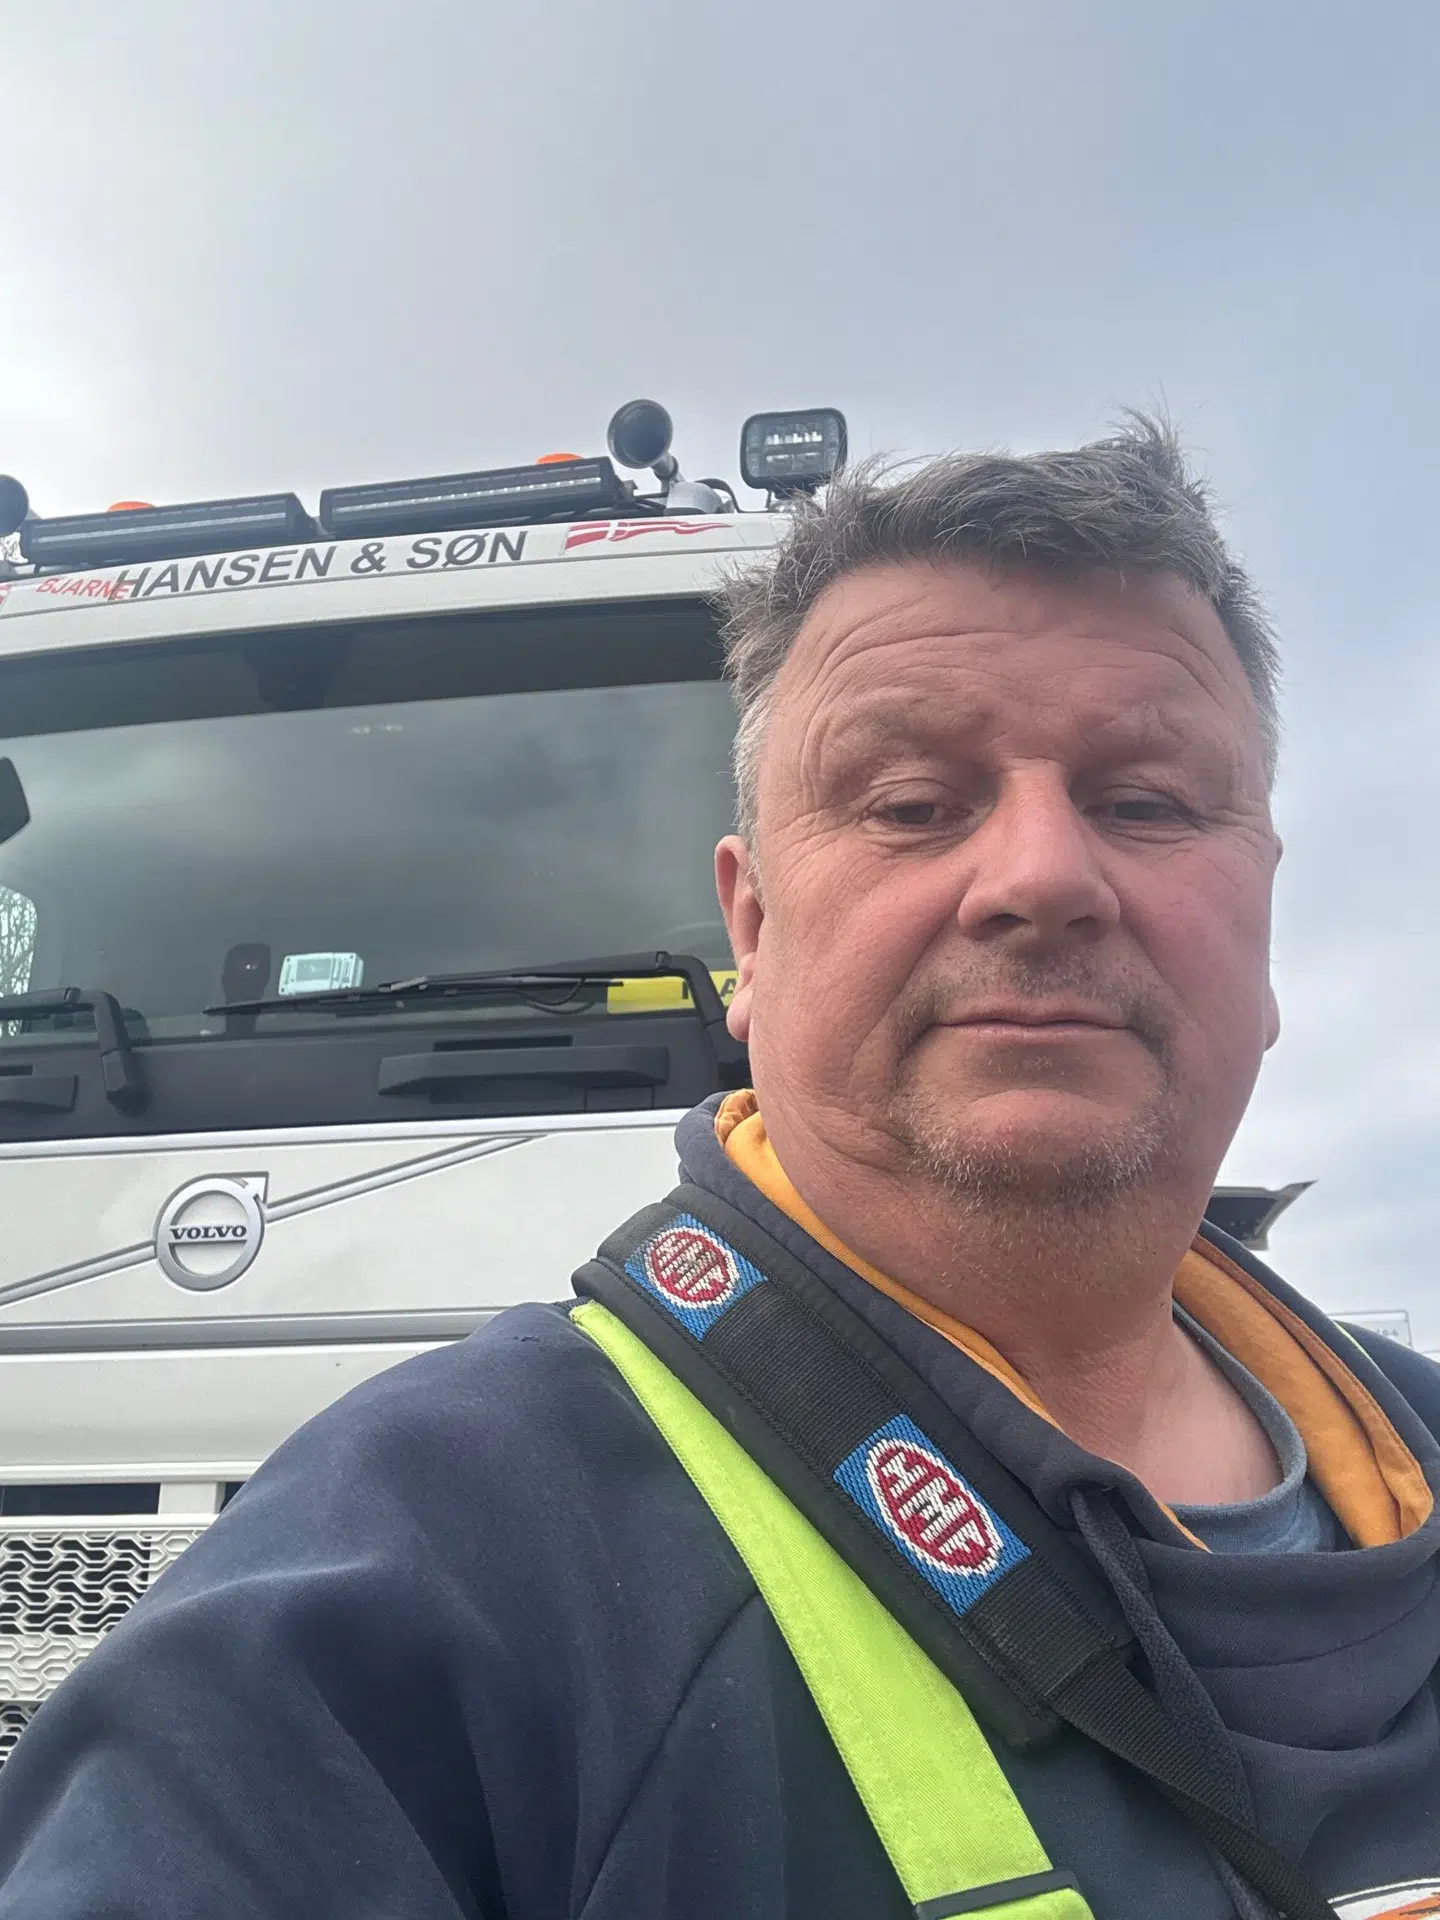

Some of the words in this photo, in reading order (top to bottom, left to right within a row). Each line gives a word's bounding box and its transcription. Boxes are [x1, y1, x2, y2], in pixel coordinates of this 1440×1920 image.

[35, 577, 131, 601] BJARNE
[107, 545, 337, 601] HANSEN
[350, 541, 387, 573] &
[405, 530, 528, 568] SØN
[169, 1225, 247, 1240] VOLVO
[656, 1234, 726, 1296] HMF
[880, 1452, 985, 1556] HMF
